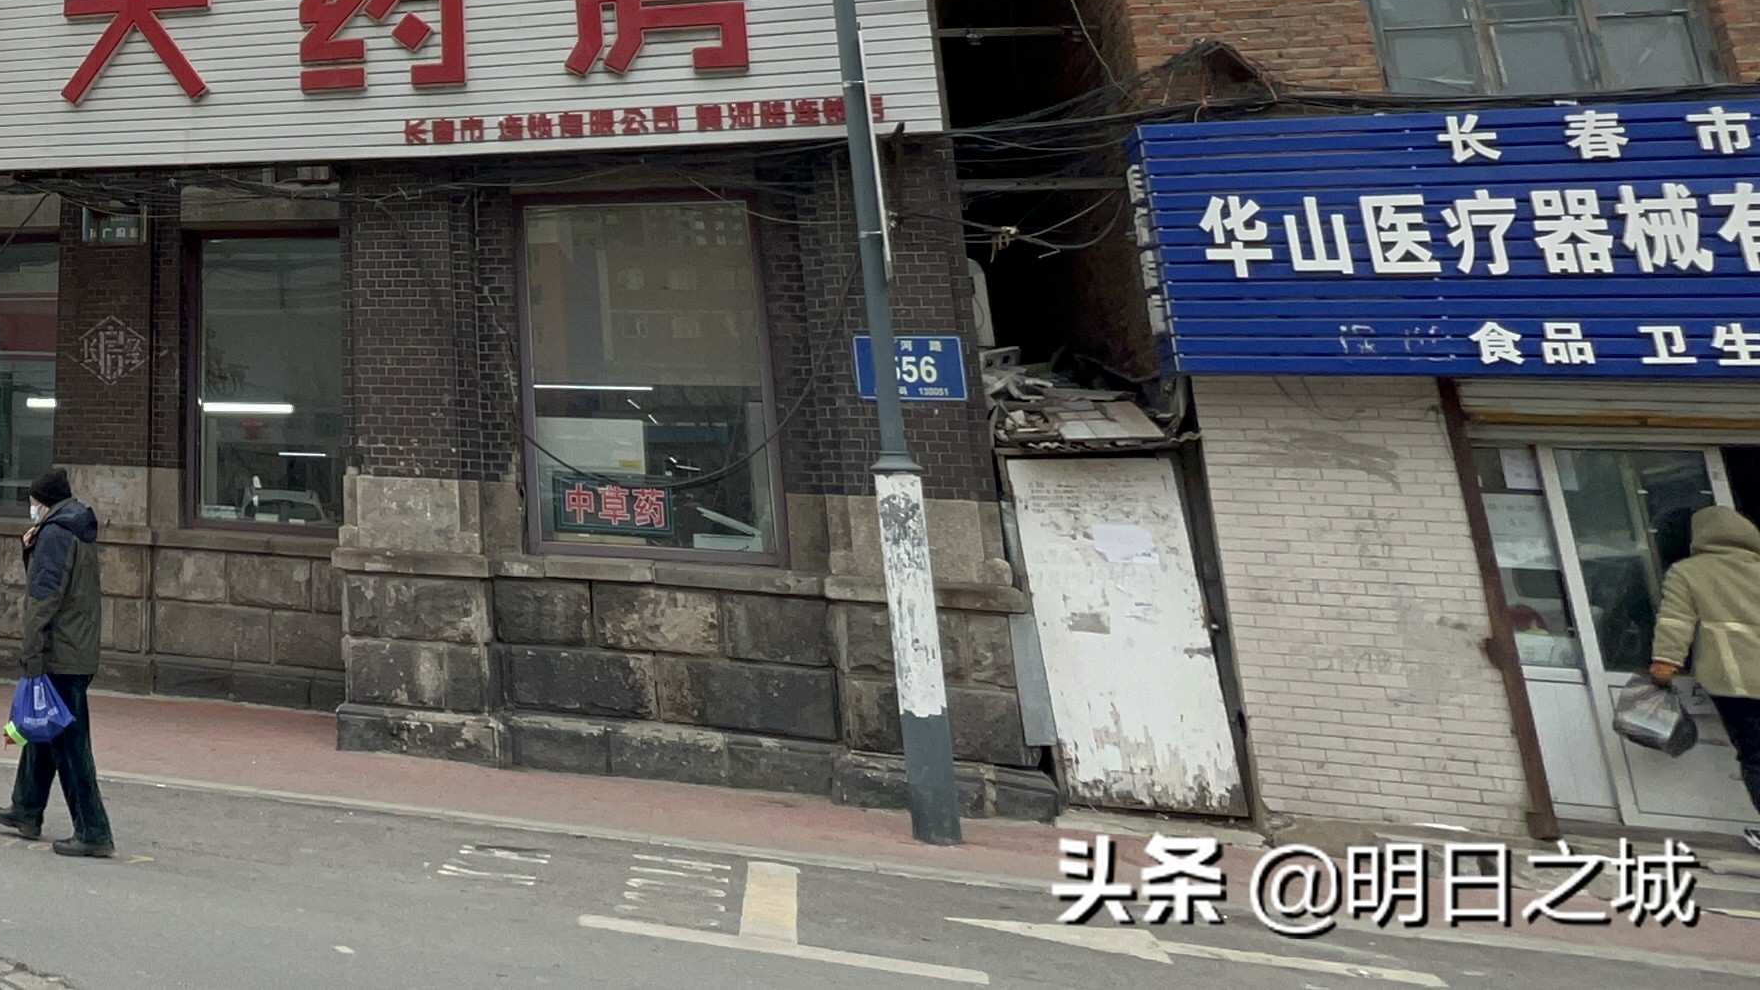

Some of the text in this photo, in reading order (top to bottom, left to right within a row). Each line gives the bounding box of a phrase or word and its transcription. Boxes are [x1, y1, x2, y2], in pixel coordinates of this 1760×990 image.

[404, 116, 484, 145] 长春市
[1437, 105, 1752, 164] 长春市
[1468, 320, 1596, 366] 食品
[565, 482, 666, 528] 中草药
